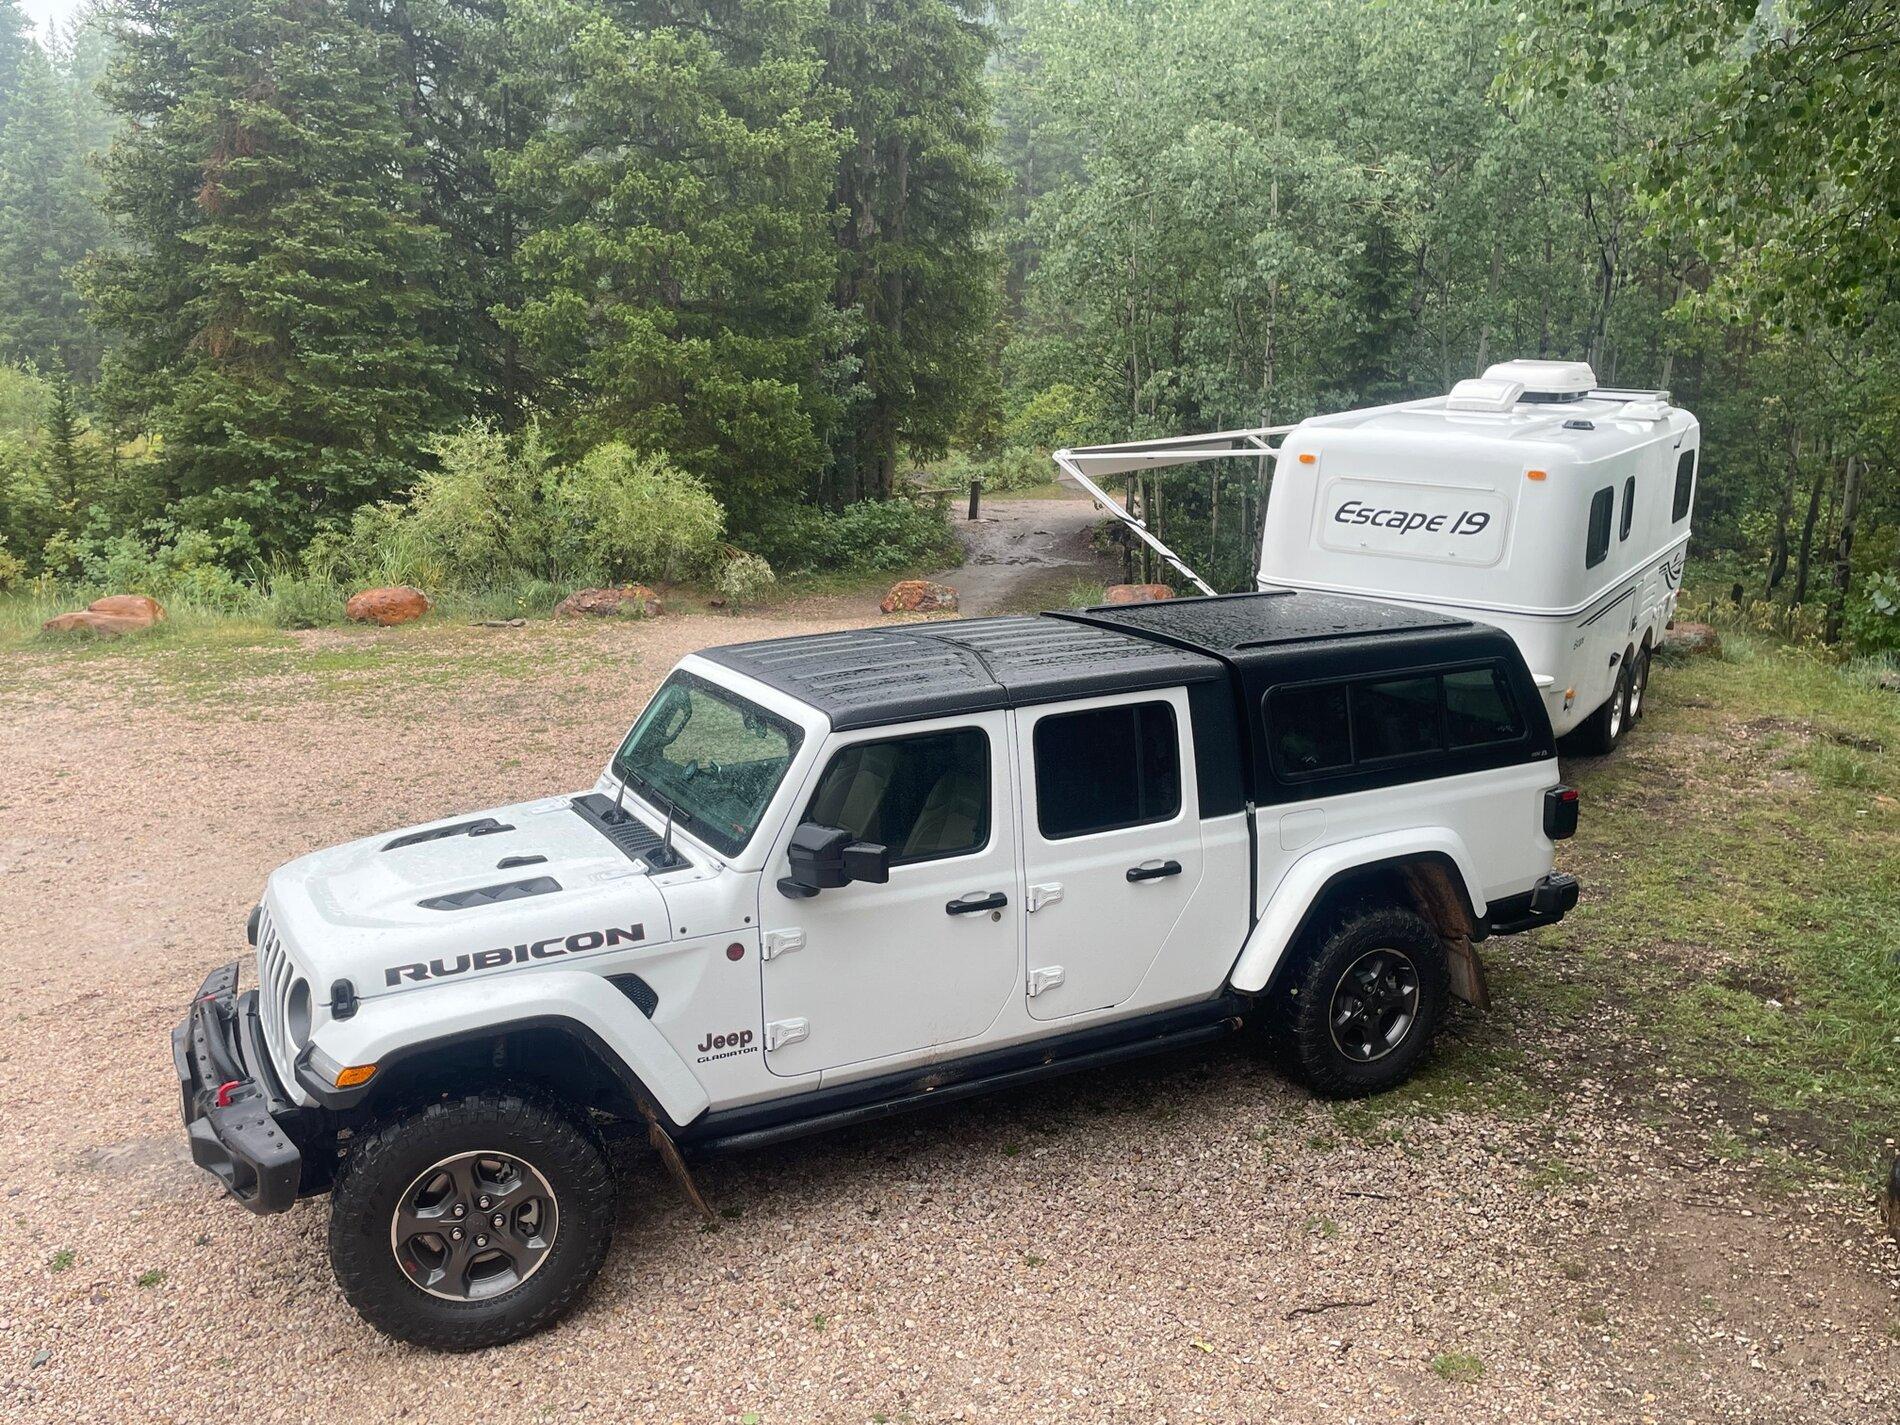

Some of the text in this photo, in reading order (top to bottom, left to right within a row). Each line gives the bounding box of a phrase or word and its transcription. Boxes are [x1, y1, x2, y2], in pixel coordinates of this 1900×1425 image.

[1334, 501, 1491, 535] Escape 19
[385, 923, 645, 987] RUBICON
[697, 1029, 753, 1052] Jeep
[697, 1046, 758, 1063] GLADIATOR
